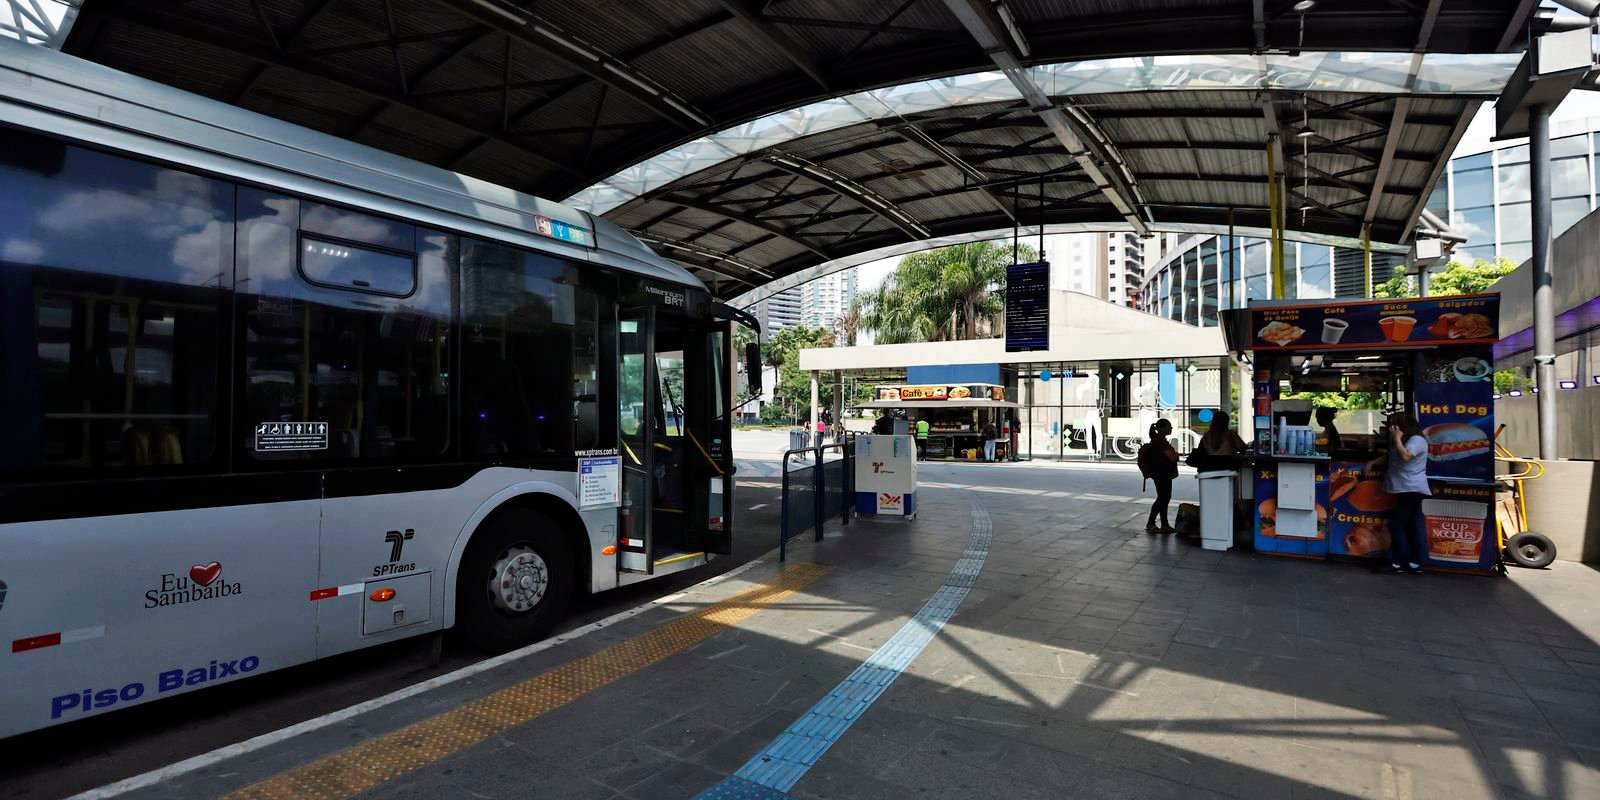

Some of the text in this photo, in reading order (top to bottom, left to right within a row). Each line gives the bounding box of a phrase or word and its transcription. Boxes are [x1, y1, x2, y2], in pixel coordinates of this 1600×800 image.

[645, 286, 684, 300] Millennium
[664, 296, 684, 307] BRT
[1420, 404, 1488, 416] Hot Dog
[1338, 513, 1385, 526] Croiss
[1441, 522, 1469, 531] CUP
[1432, 529, 1476, 540] NOODLES
[373, 562, 416, 577] SPTrans
[160, 573, 188, 592] Eu
[144, 579, 242, 609] Sambaíba
[51, 655, 260, 719] Piso Baixo
